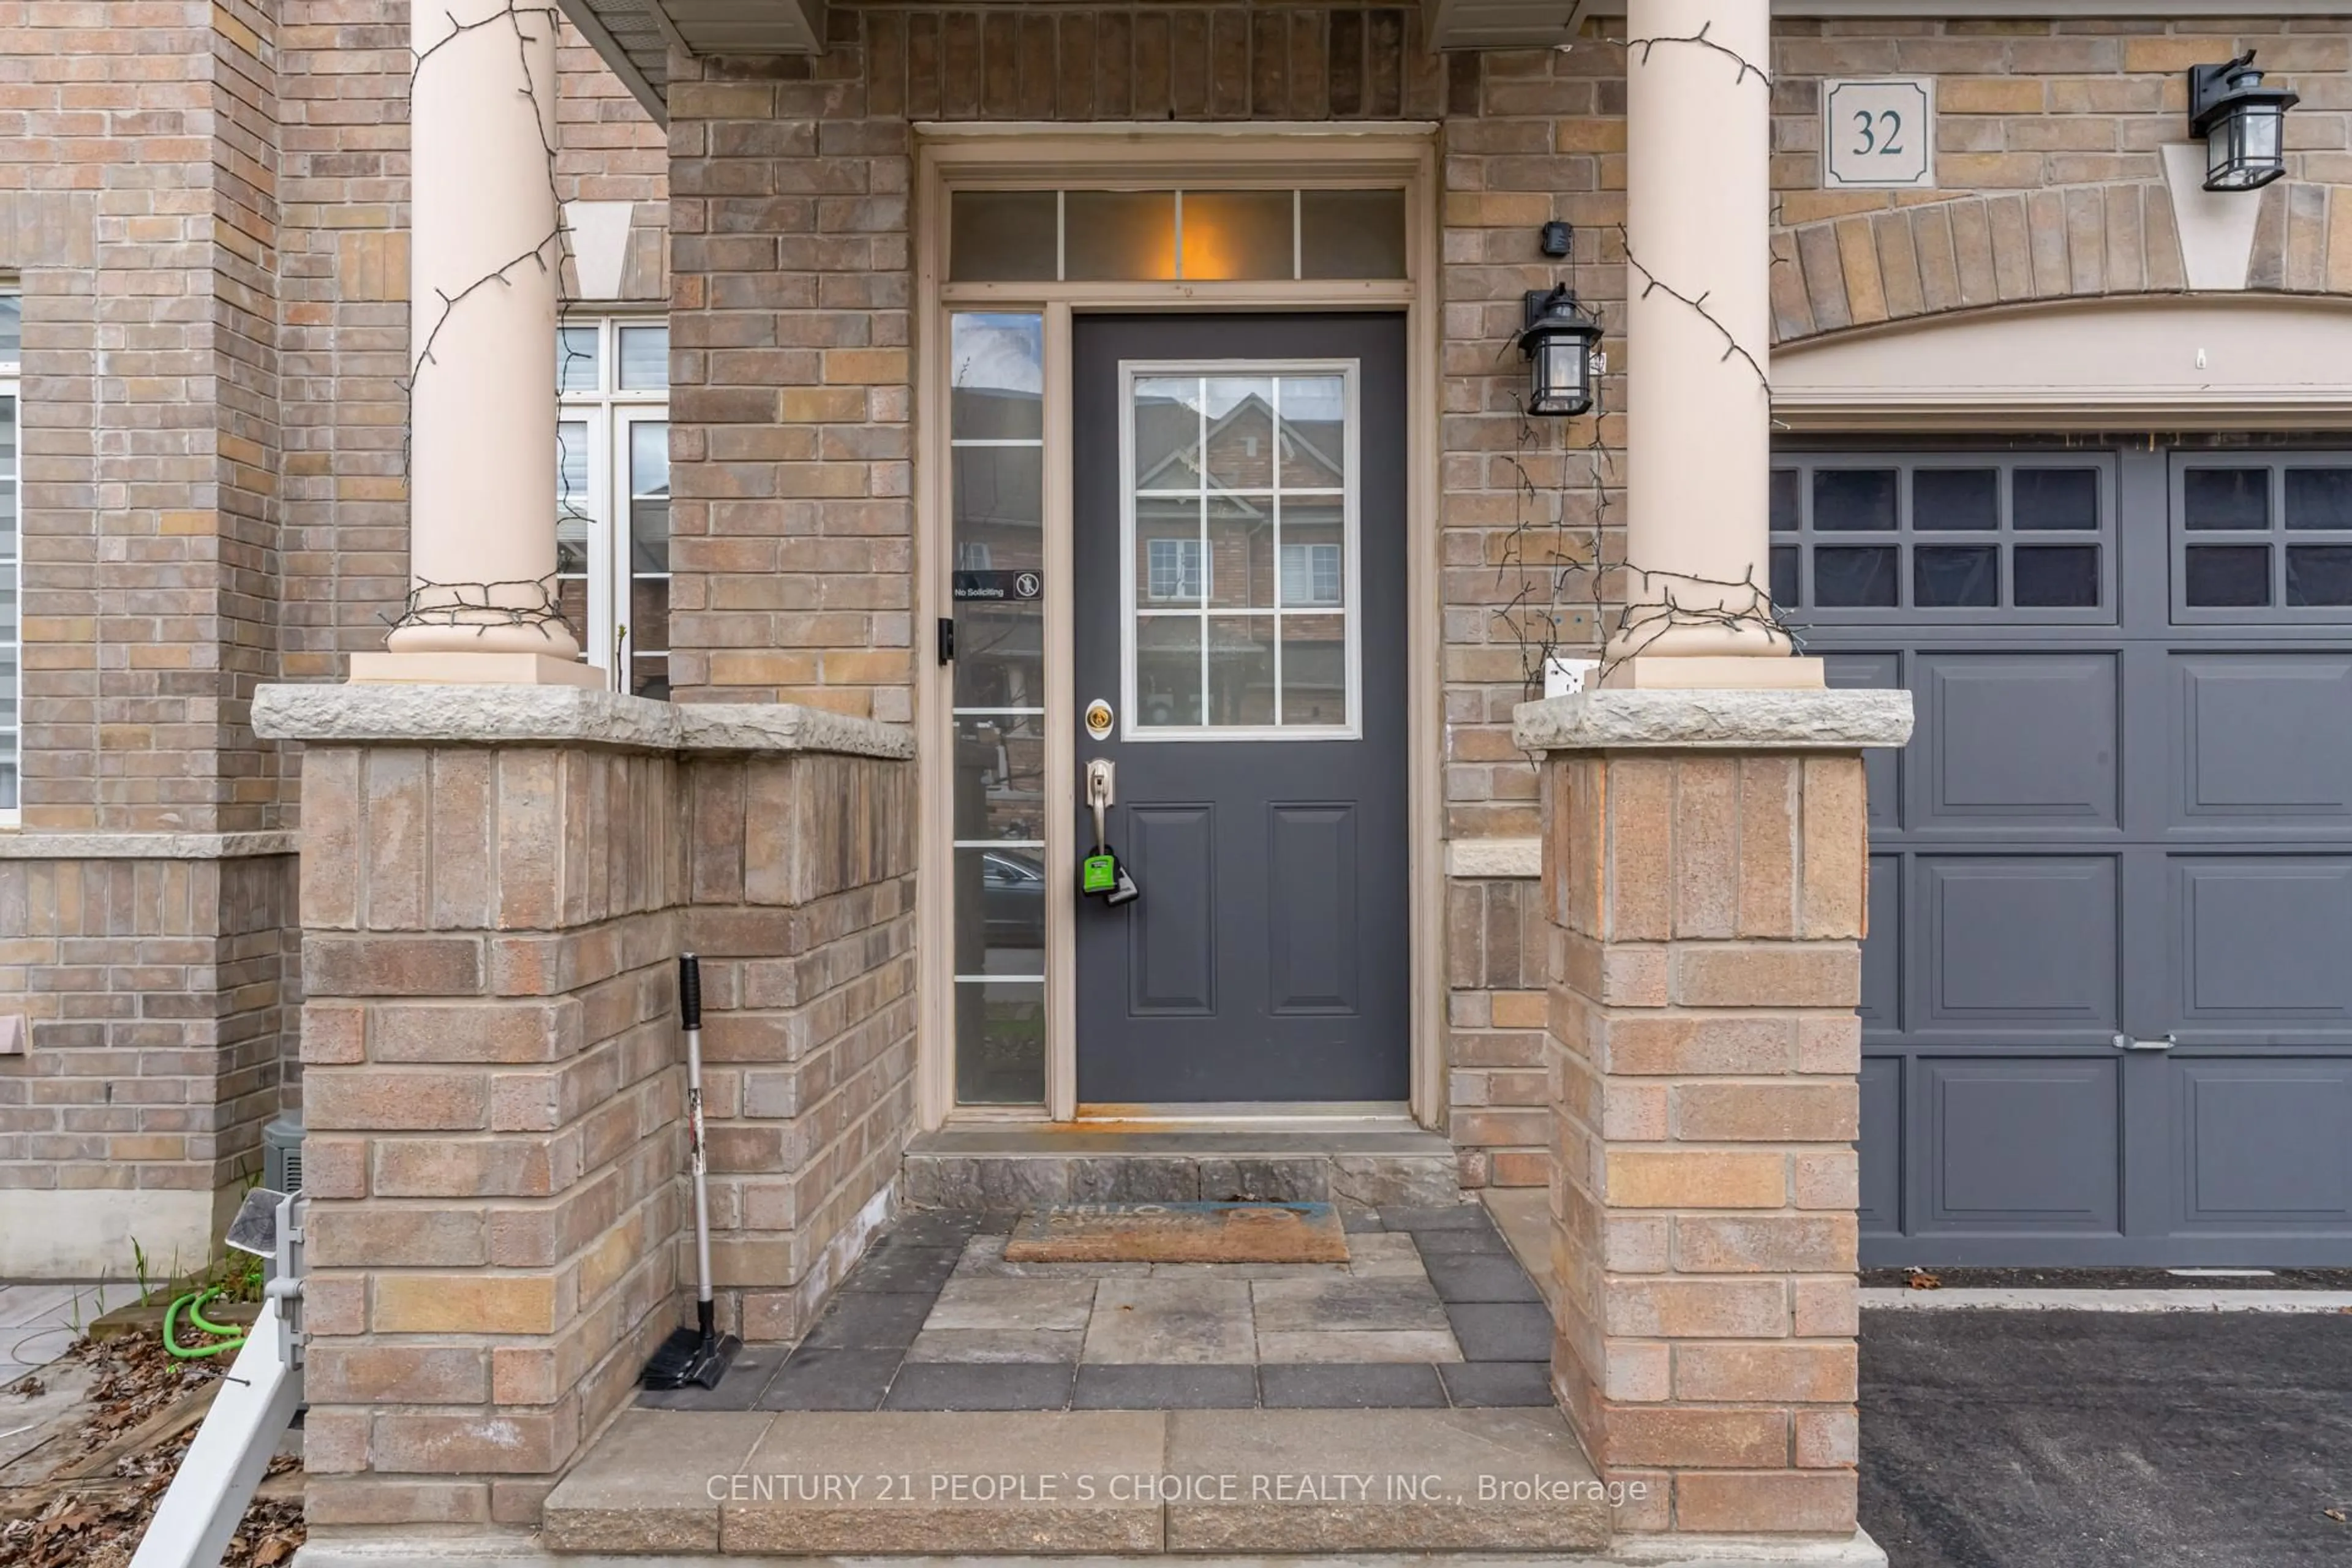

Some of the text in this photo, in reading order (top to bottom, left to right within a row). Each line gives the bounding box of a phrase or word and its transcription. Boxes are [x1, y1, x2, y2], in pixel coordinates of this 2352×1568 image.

[1853, 110, 1903, 154] 32
[968, 588, 1004, 597] Soliciting
[1049, 1204, 1167, 1216] HELLO
